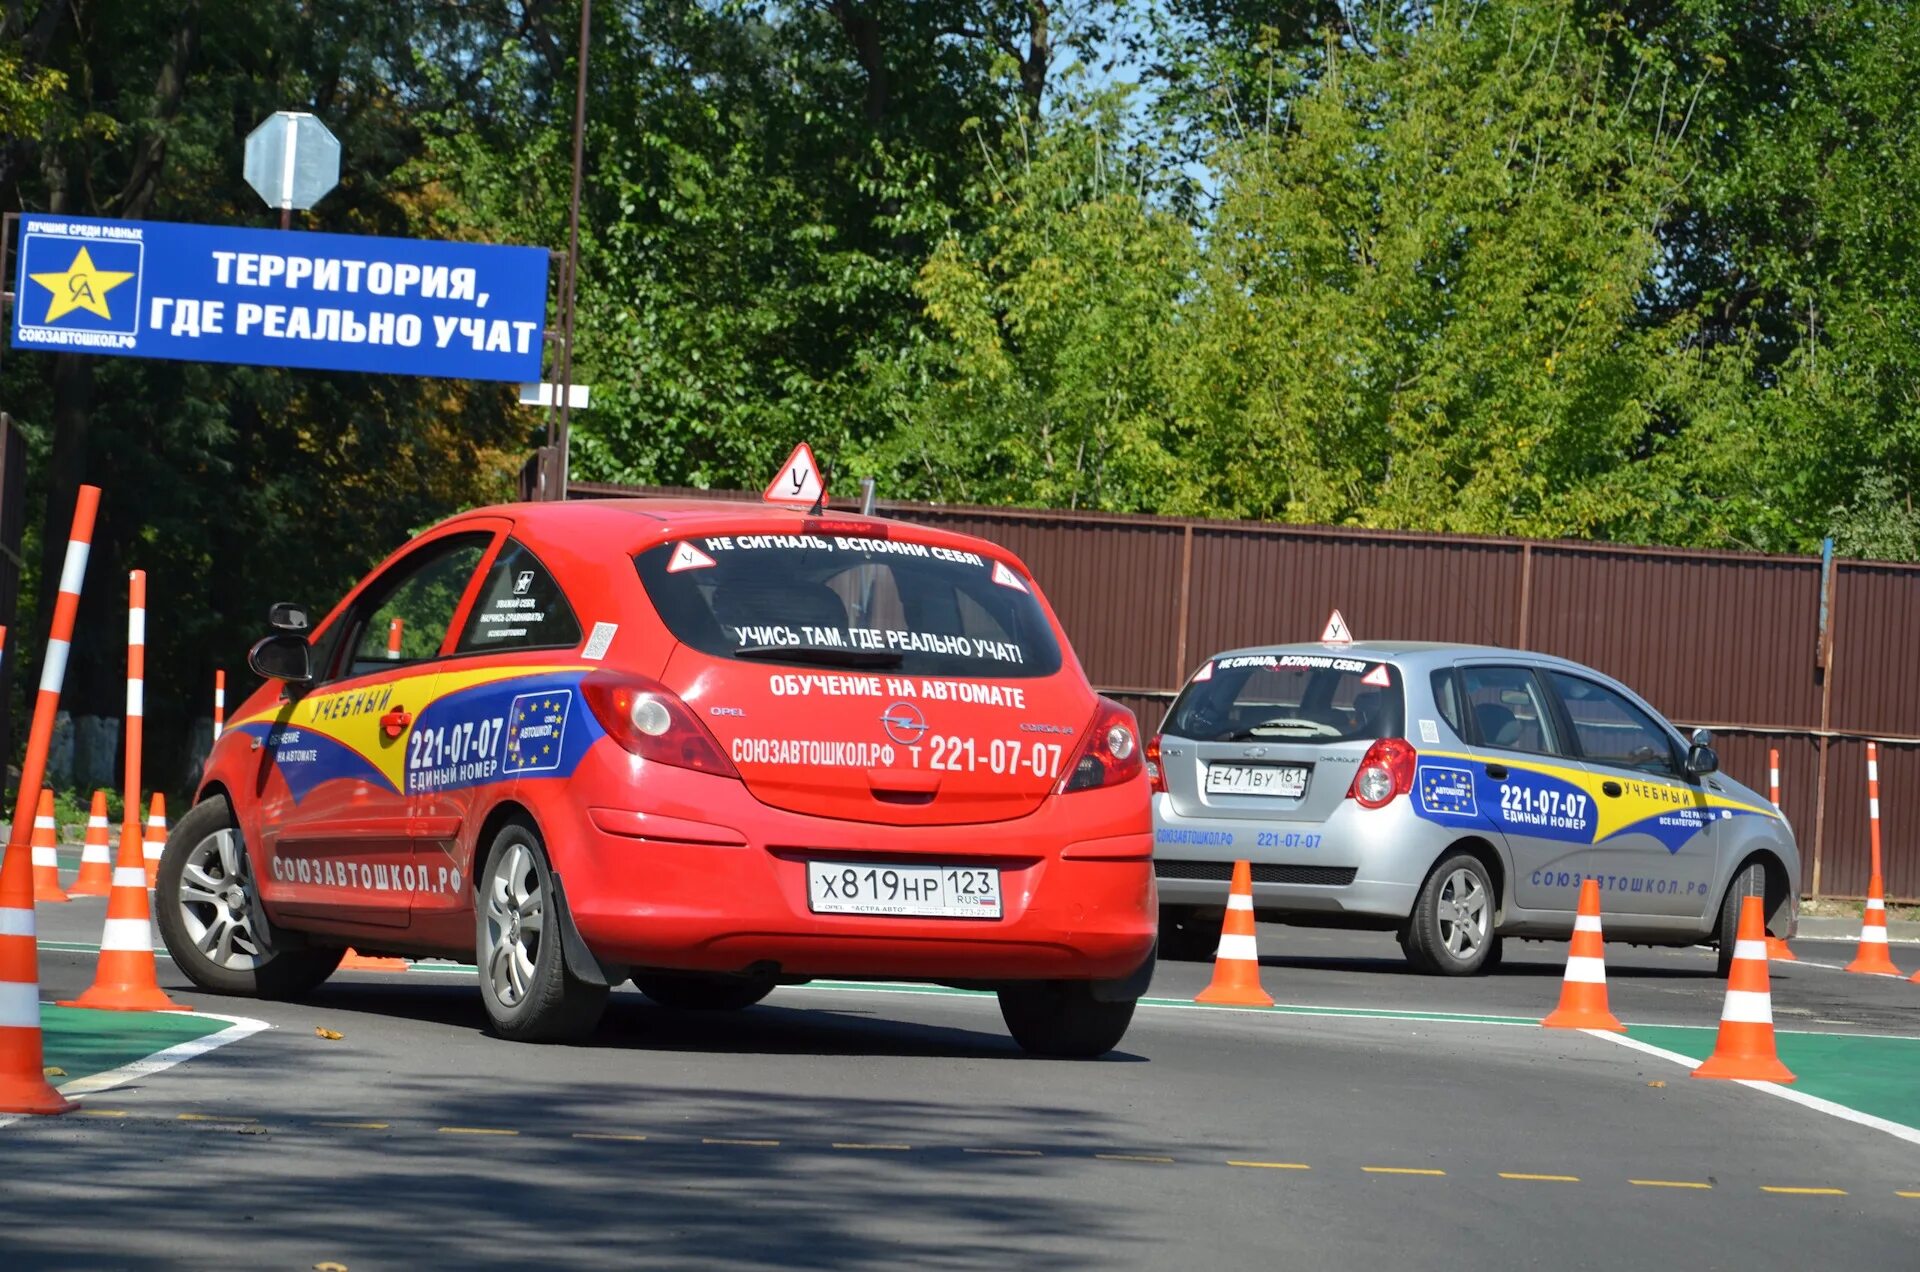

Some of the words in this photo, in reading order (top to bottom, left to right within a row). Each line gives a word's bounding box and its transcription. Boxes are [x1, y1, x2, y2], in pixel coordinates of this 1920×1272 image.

[27, 221, 68, 235] ЛУЧШИЕ
[69, 223, 101, 238] СРЕДИ
[102, 226, 143, 240] РАВНЫХ
[212, 251, 490, 308] ТЕРРИТОРИЯ,
[150, 297, 224, 337] ГДЕ
[236, 302, 422, 348] РЕАЛЬНО
[433, 315, 537, 354] УЧАТ
[18, 328, 136, 349] СОЮЗАВТОШКОЛ.РФ
[791, 468, 809, 496] У
[705, 537, 735, 551] НЕ
[736, 535, 833, 552] СИГНАЛЬ,
[834, 537, 930, 558] ВСПОМНИ
[930, 546, 985, 567] СЕБЯ!
[1330, 623, 1341, 639] У
[734, 626, 800, 646] УЧИСЬ
[848, 628, 883, 650] ГДЕ
[886, 630, 971, 657] РЕАЛЬНО
[971, 638, 1024, 665] УЧАТ!
[1218, 659, 1233, 670] НЕ
[1232, 656, 1278, 668] СИГНАЛЬ,
[1279, 656, 1334, 669] ВСПОМНИ
[1332, 659, 1367, 673] СЕБЯ!
[312, 684, 393, 724] УЧЕБНЫЙ
[769, 675, 883, 697] ОБУЧЕНИЕ
[886, 678, 916, 698] НА
[921, 680, 1026, 709] АВТОМАТЕ
[710, 707, 747, 717] OPEL
[410, 717, 504, 769] 221-07-07
[277, 751, 286, 762] НА
[286, 750, 318, 762] АВТОМАТЕ
[732, 738, 895, 767] СОЮЗАВТОШКОЛ.РФ
[930, 735, 1062, 778] 221-07-07
[410, 763, 457, 791] ЕДИНЫЙ
[460, 759, 498, 781] НОМЕР
[1279, 769, 1302, 783] 161
[1500, 784, 1587, 819] 221-07-07
[1624, 781, 1691, 806] УЧЕБНЫЙ
[1503, 809, 1548, 825] ЕДИНЫЙ
[1551, 817, 1587, 830] НОМЕР
[1659, 817, 1671, 826] ВСЕ
[1680, 810, 1692, 819] ВСЕ
[1156, 828, 1234, 847] СОЮЗАВТОШКОЛ.РФ
[1257, 832, 1322, 848] 221-07-07
[273, 855, 462, 894] СОЮЗАВТОШКОЛ.РФ
[947, 871, 991, 894] 123
[1532, 871, 1708, 896] СОЮЗВТОШКОЛ.РФ
[957, 895, 979, 905] RUS
